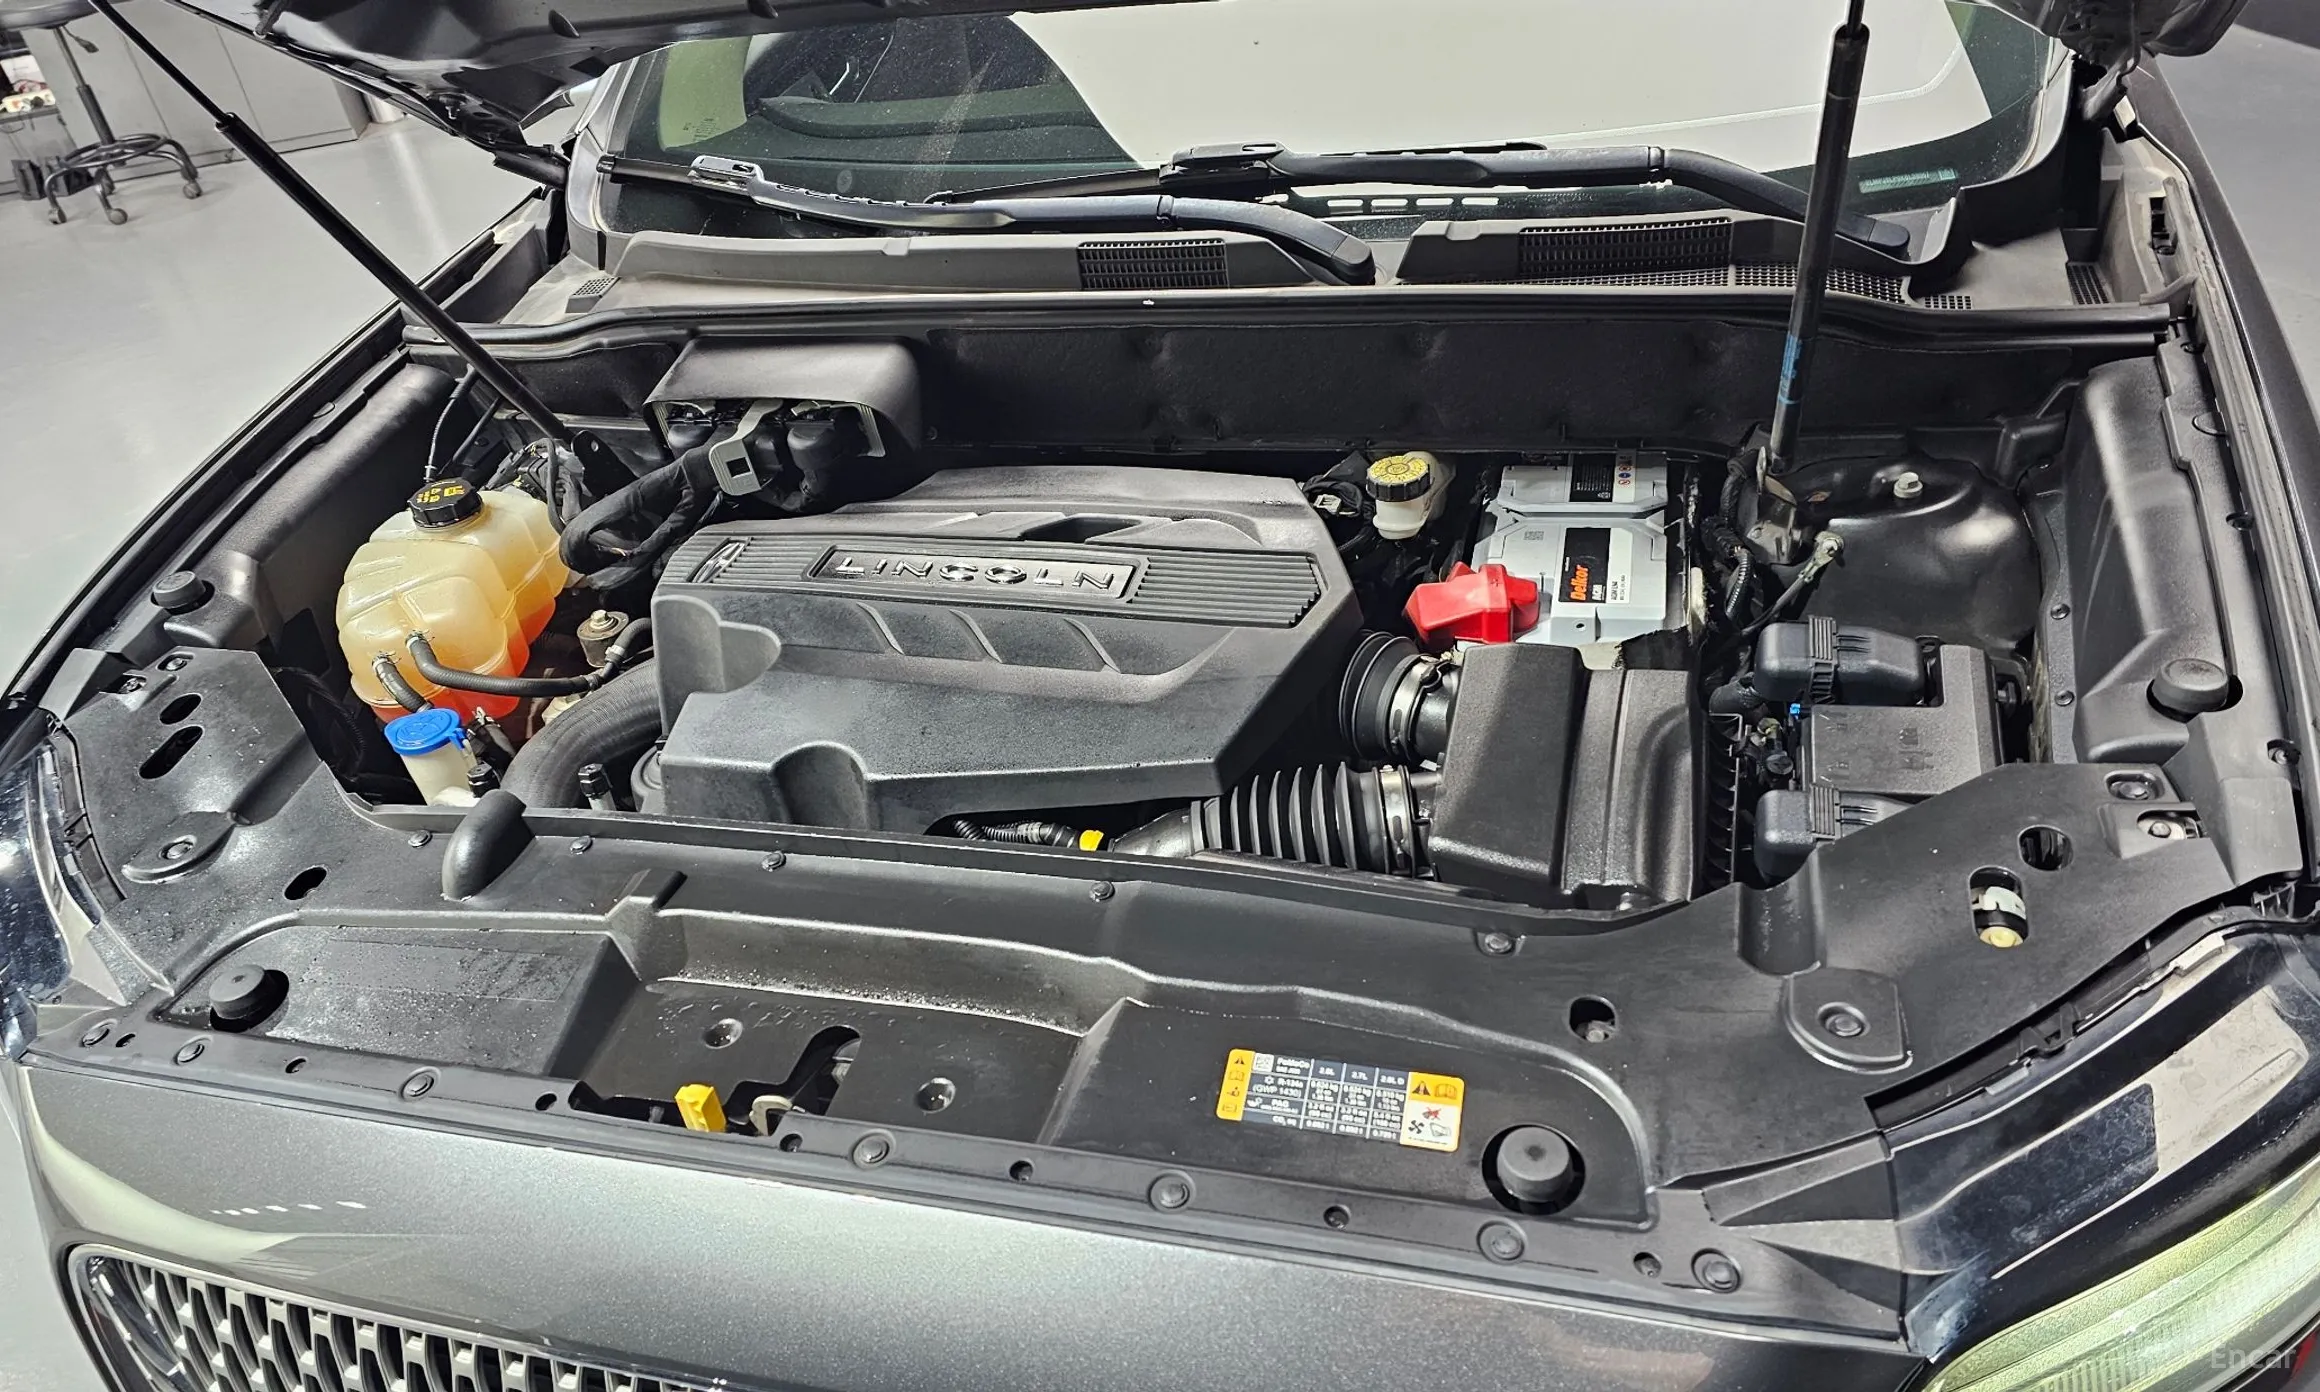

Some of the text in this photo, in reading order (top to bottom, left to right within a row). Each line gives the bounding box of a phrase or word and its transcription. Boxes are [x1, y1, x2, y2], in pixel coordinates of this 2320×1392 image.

[835, 556, 1115, 590] LINCOLN
[1570, 564, 1589, 601] Delkor
[1592, 584, 1603, 601] AGM
[1351, 1071, 1368, 1080] 2.7L
[1279, 1087, 1302, 1098] 1430)
